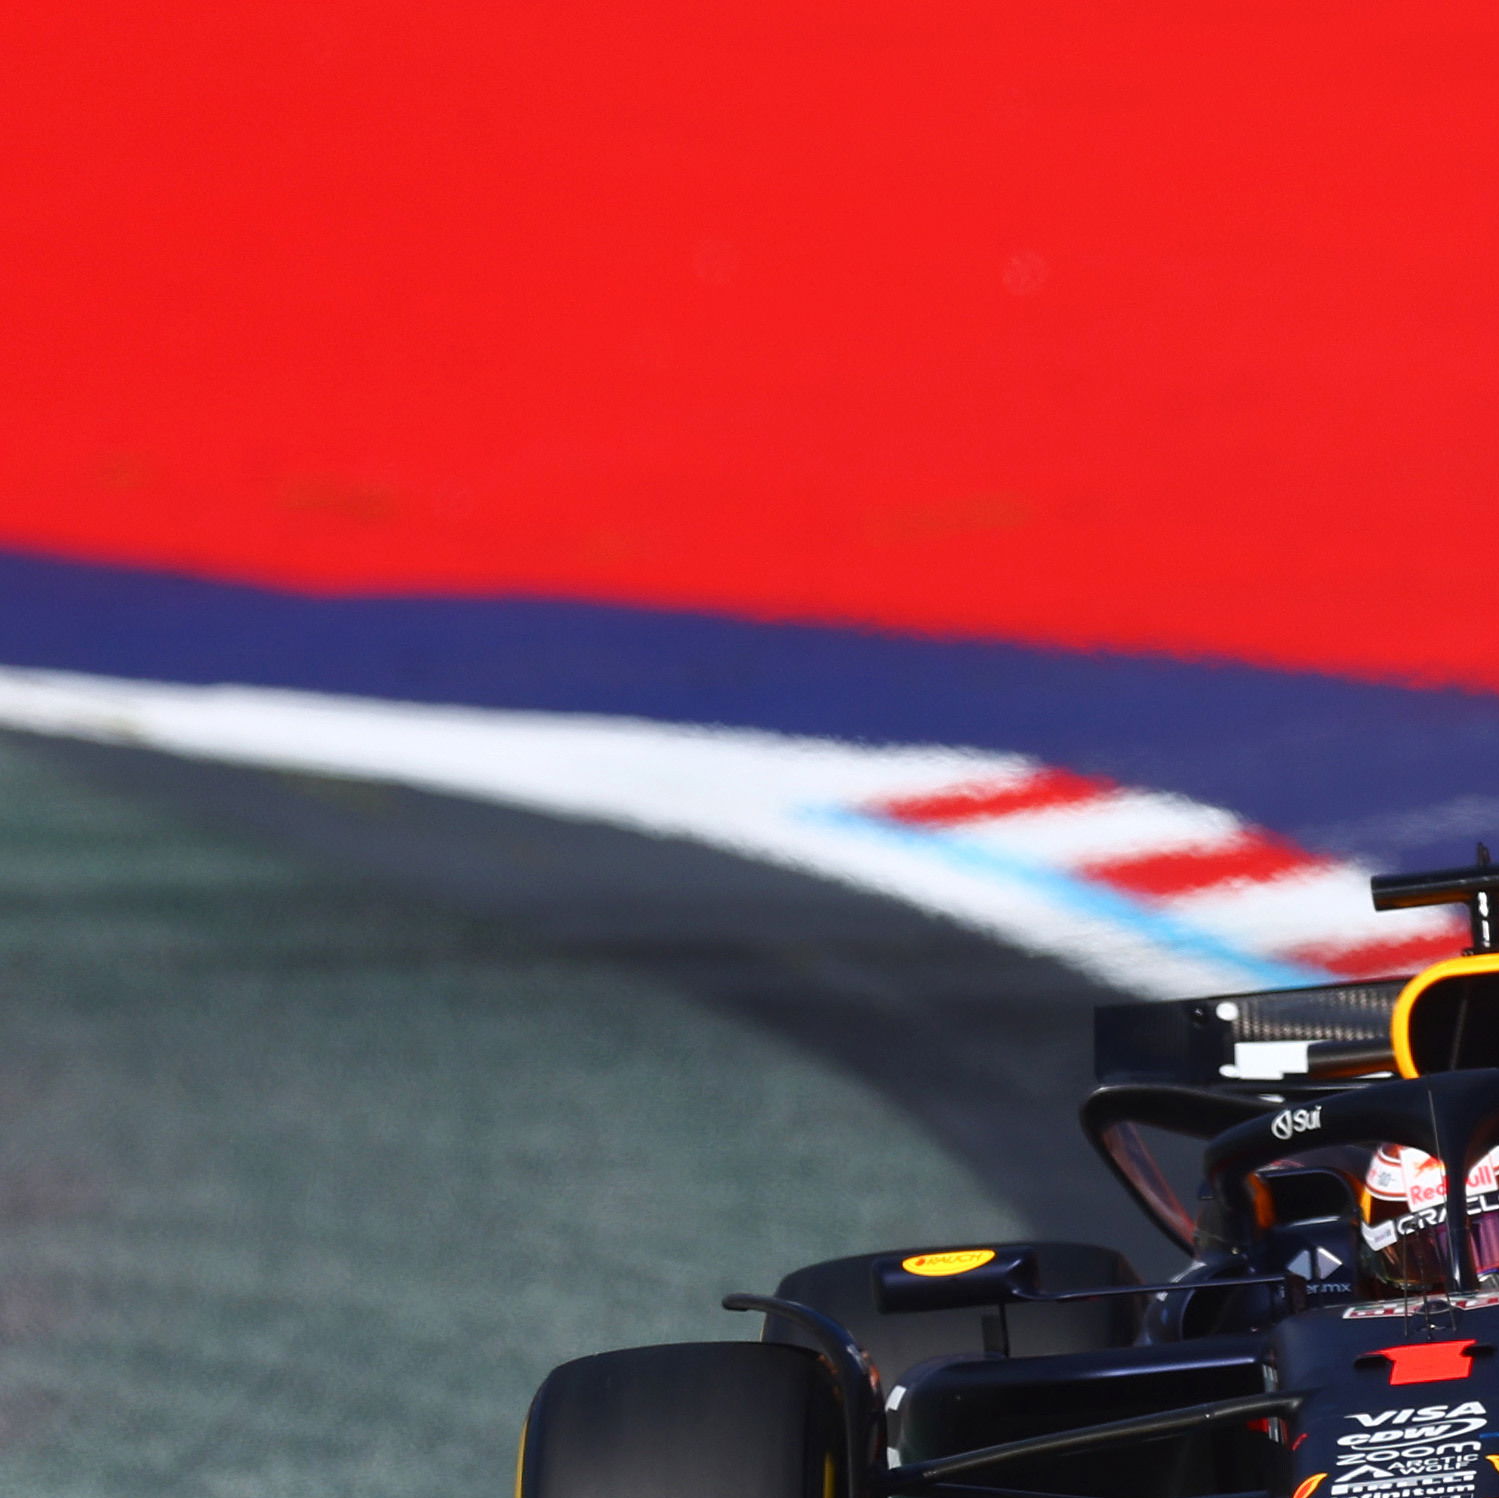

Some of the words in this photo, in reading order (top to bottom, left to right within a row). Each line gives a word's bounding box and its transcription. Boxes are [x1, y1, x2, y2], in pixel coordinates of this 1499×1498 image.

[1293, 1104, 1322, 1132] Sui
[1465, 1165, 1493, 1187] ull
[1344, 1401, 1487, 1427] VISA
[1337, 1422, 1454, 1446] CDW
[1388, 1453, 1479, 1470] ARCTIC
[1400, 1461, 1471, 1475] WOLF
